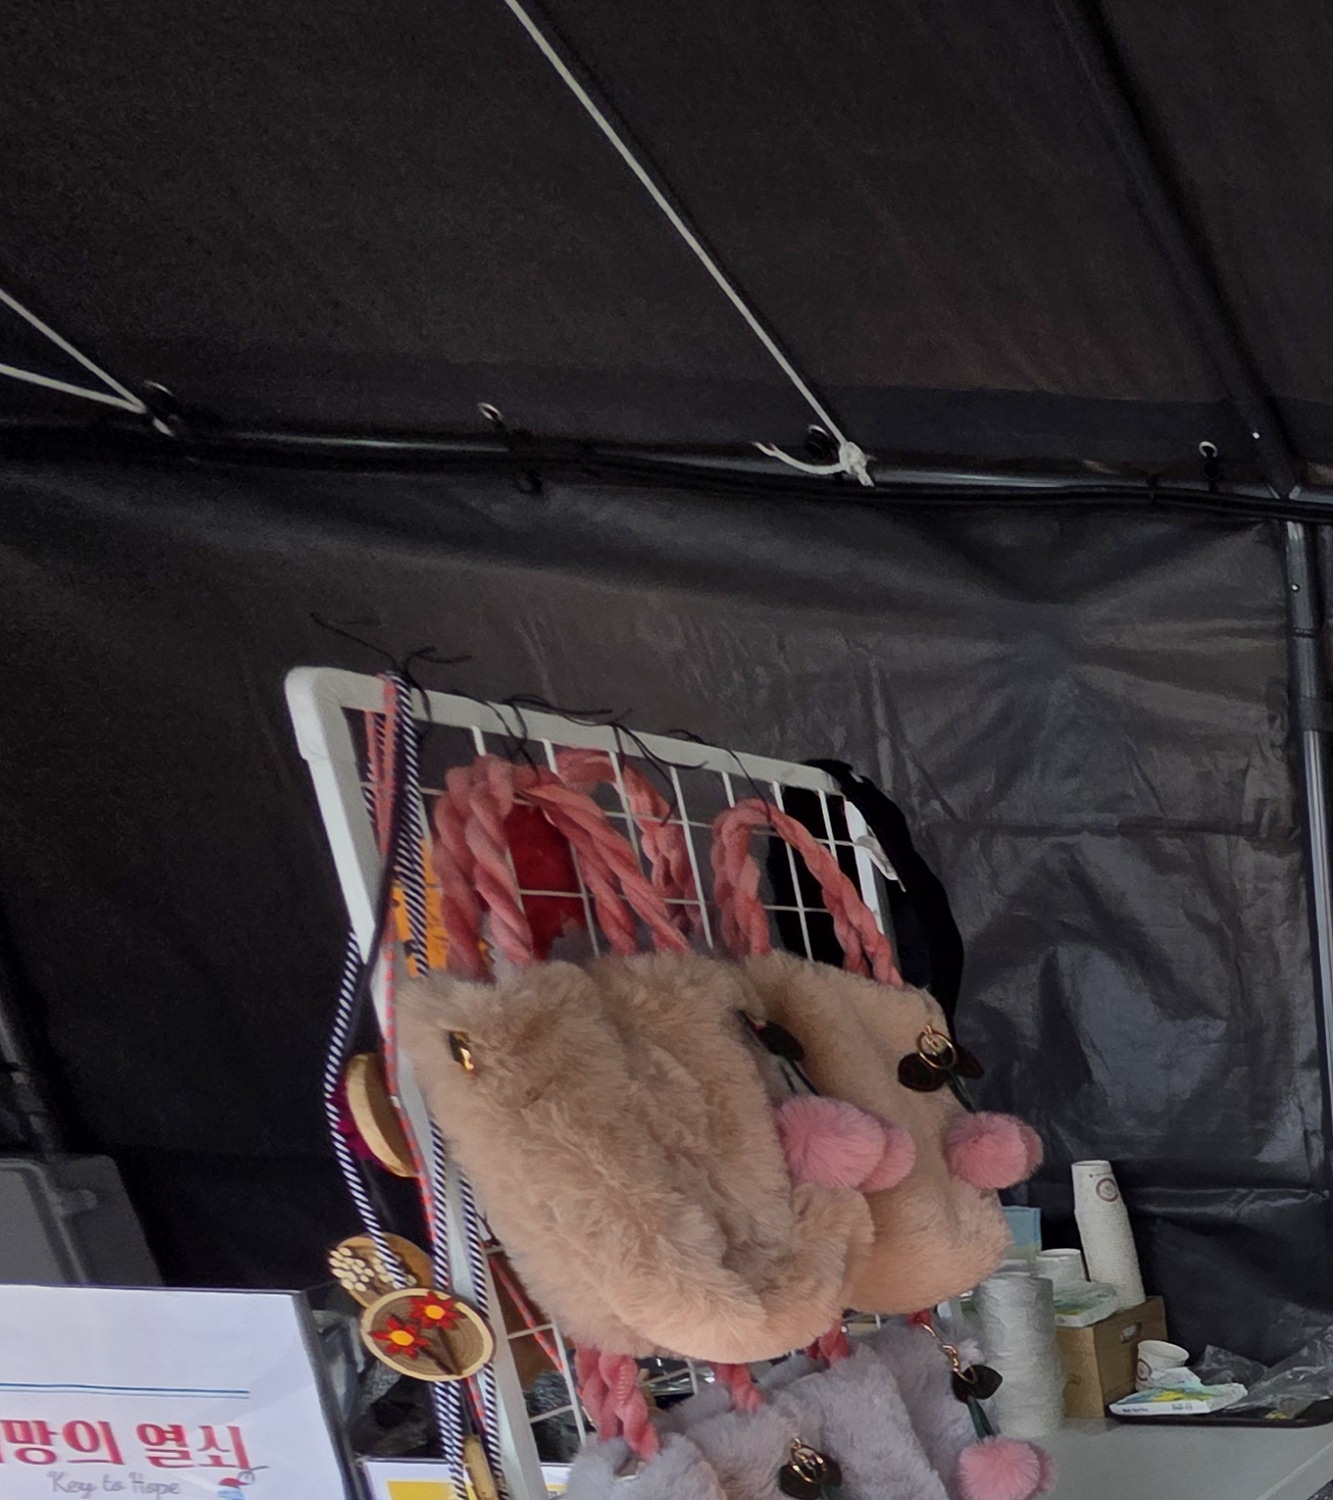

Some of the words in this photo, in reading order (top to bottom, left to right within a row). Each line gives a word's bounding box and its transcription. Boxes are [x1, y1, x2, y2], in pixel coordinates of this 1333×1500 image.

[0, 1419, 124, 1466] 망의
[135, 1423, 251, 1470] 열쇠
[47, 1470, 98, 1499] Key
[102, 1473, 125, 1492] to
[128, 1470, 181, 1500] Hope
